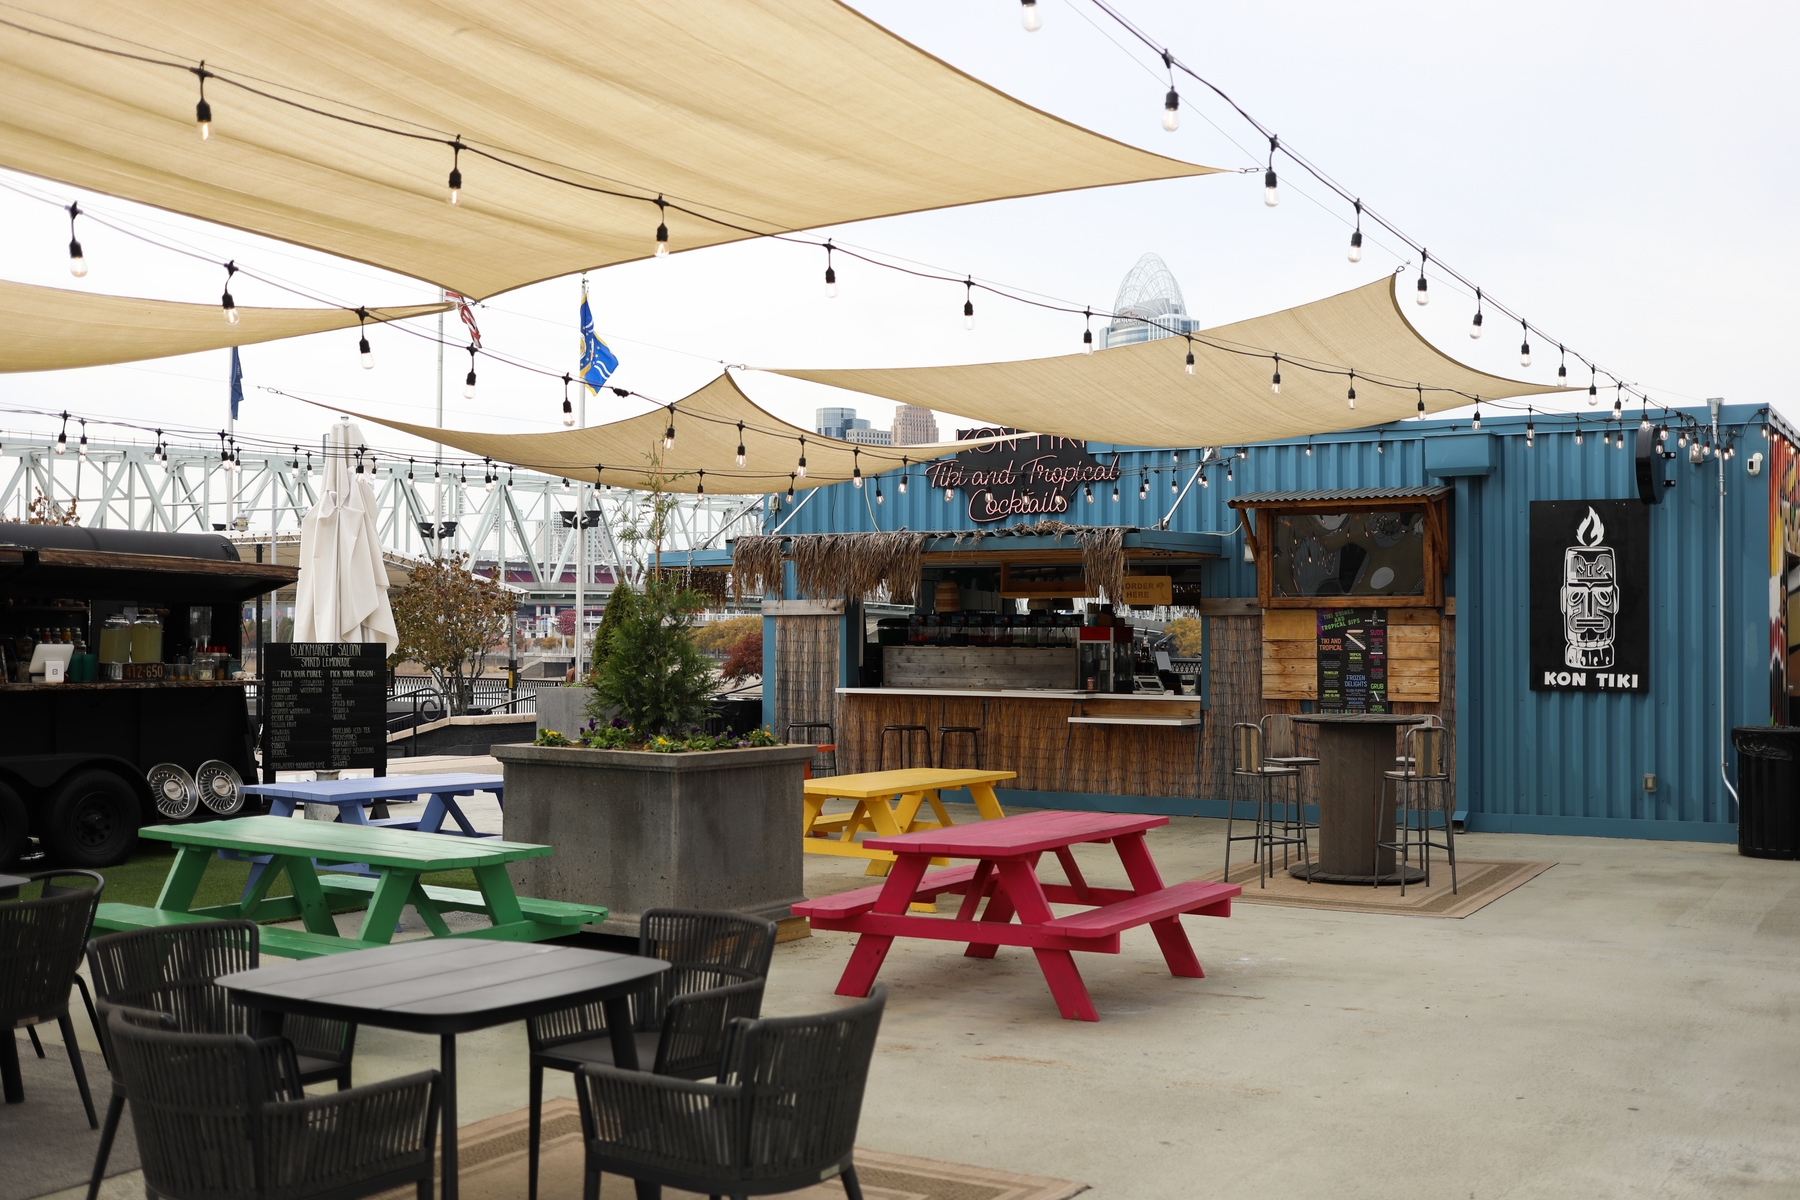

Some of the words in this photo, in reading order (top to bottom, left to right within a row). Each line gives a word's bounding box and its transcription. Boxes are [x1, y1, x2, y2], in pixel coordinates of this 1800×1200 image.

[925, 459, 968, 488] Tiki
[971, 460, 1016, 486] and
[1021, 453, 1121, 490] Tropical
[968, 487, 1068, 523] Cocktails
[1125, 582, 1154, 590] ORDER
[1321, 621, 1346, 631] TROPICAL
[1348, 617, 1360, 625] SIPS
[290, 644, 333, 656] BLACKMARKET
[337, 644, 361, 656] SALOON
[301, 658, 321, 667] SPIKED
[322, 658, 351, 667] LEMONADE
[281, 670, 292, 678] PICK
[293, 670, 305, 678] YOUR
[330, 670, 340, 678] PICK
[342, 670, 354, 678] YOUR
[356, 670, 375, 678] POISON:
[1544, 671, 1586, 686] KON
[1596, 673, 1638, 688] TIKI
